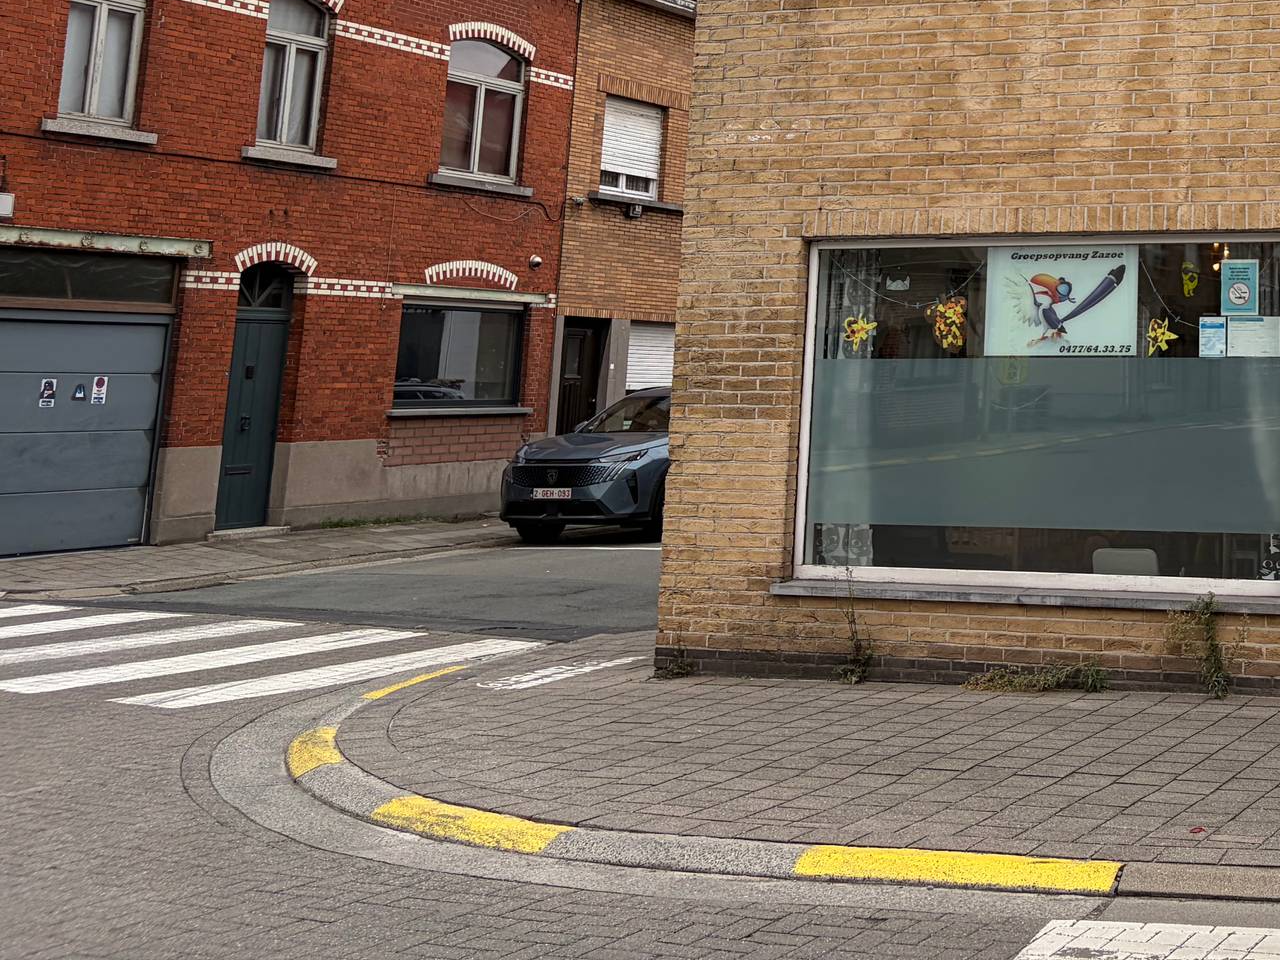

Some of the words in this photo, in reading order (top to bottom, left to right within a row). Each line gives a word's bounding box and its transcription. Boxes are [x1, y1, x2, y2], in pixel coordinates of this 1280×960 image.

[1011, 251, 1089, 261] Groepsopvang
[1091, 250, 1124, 259] Zazoe
[1059, 345, 1131, 353] 0477/64.33.75
